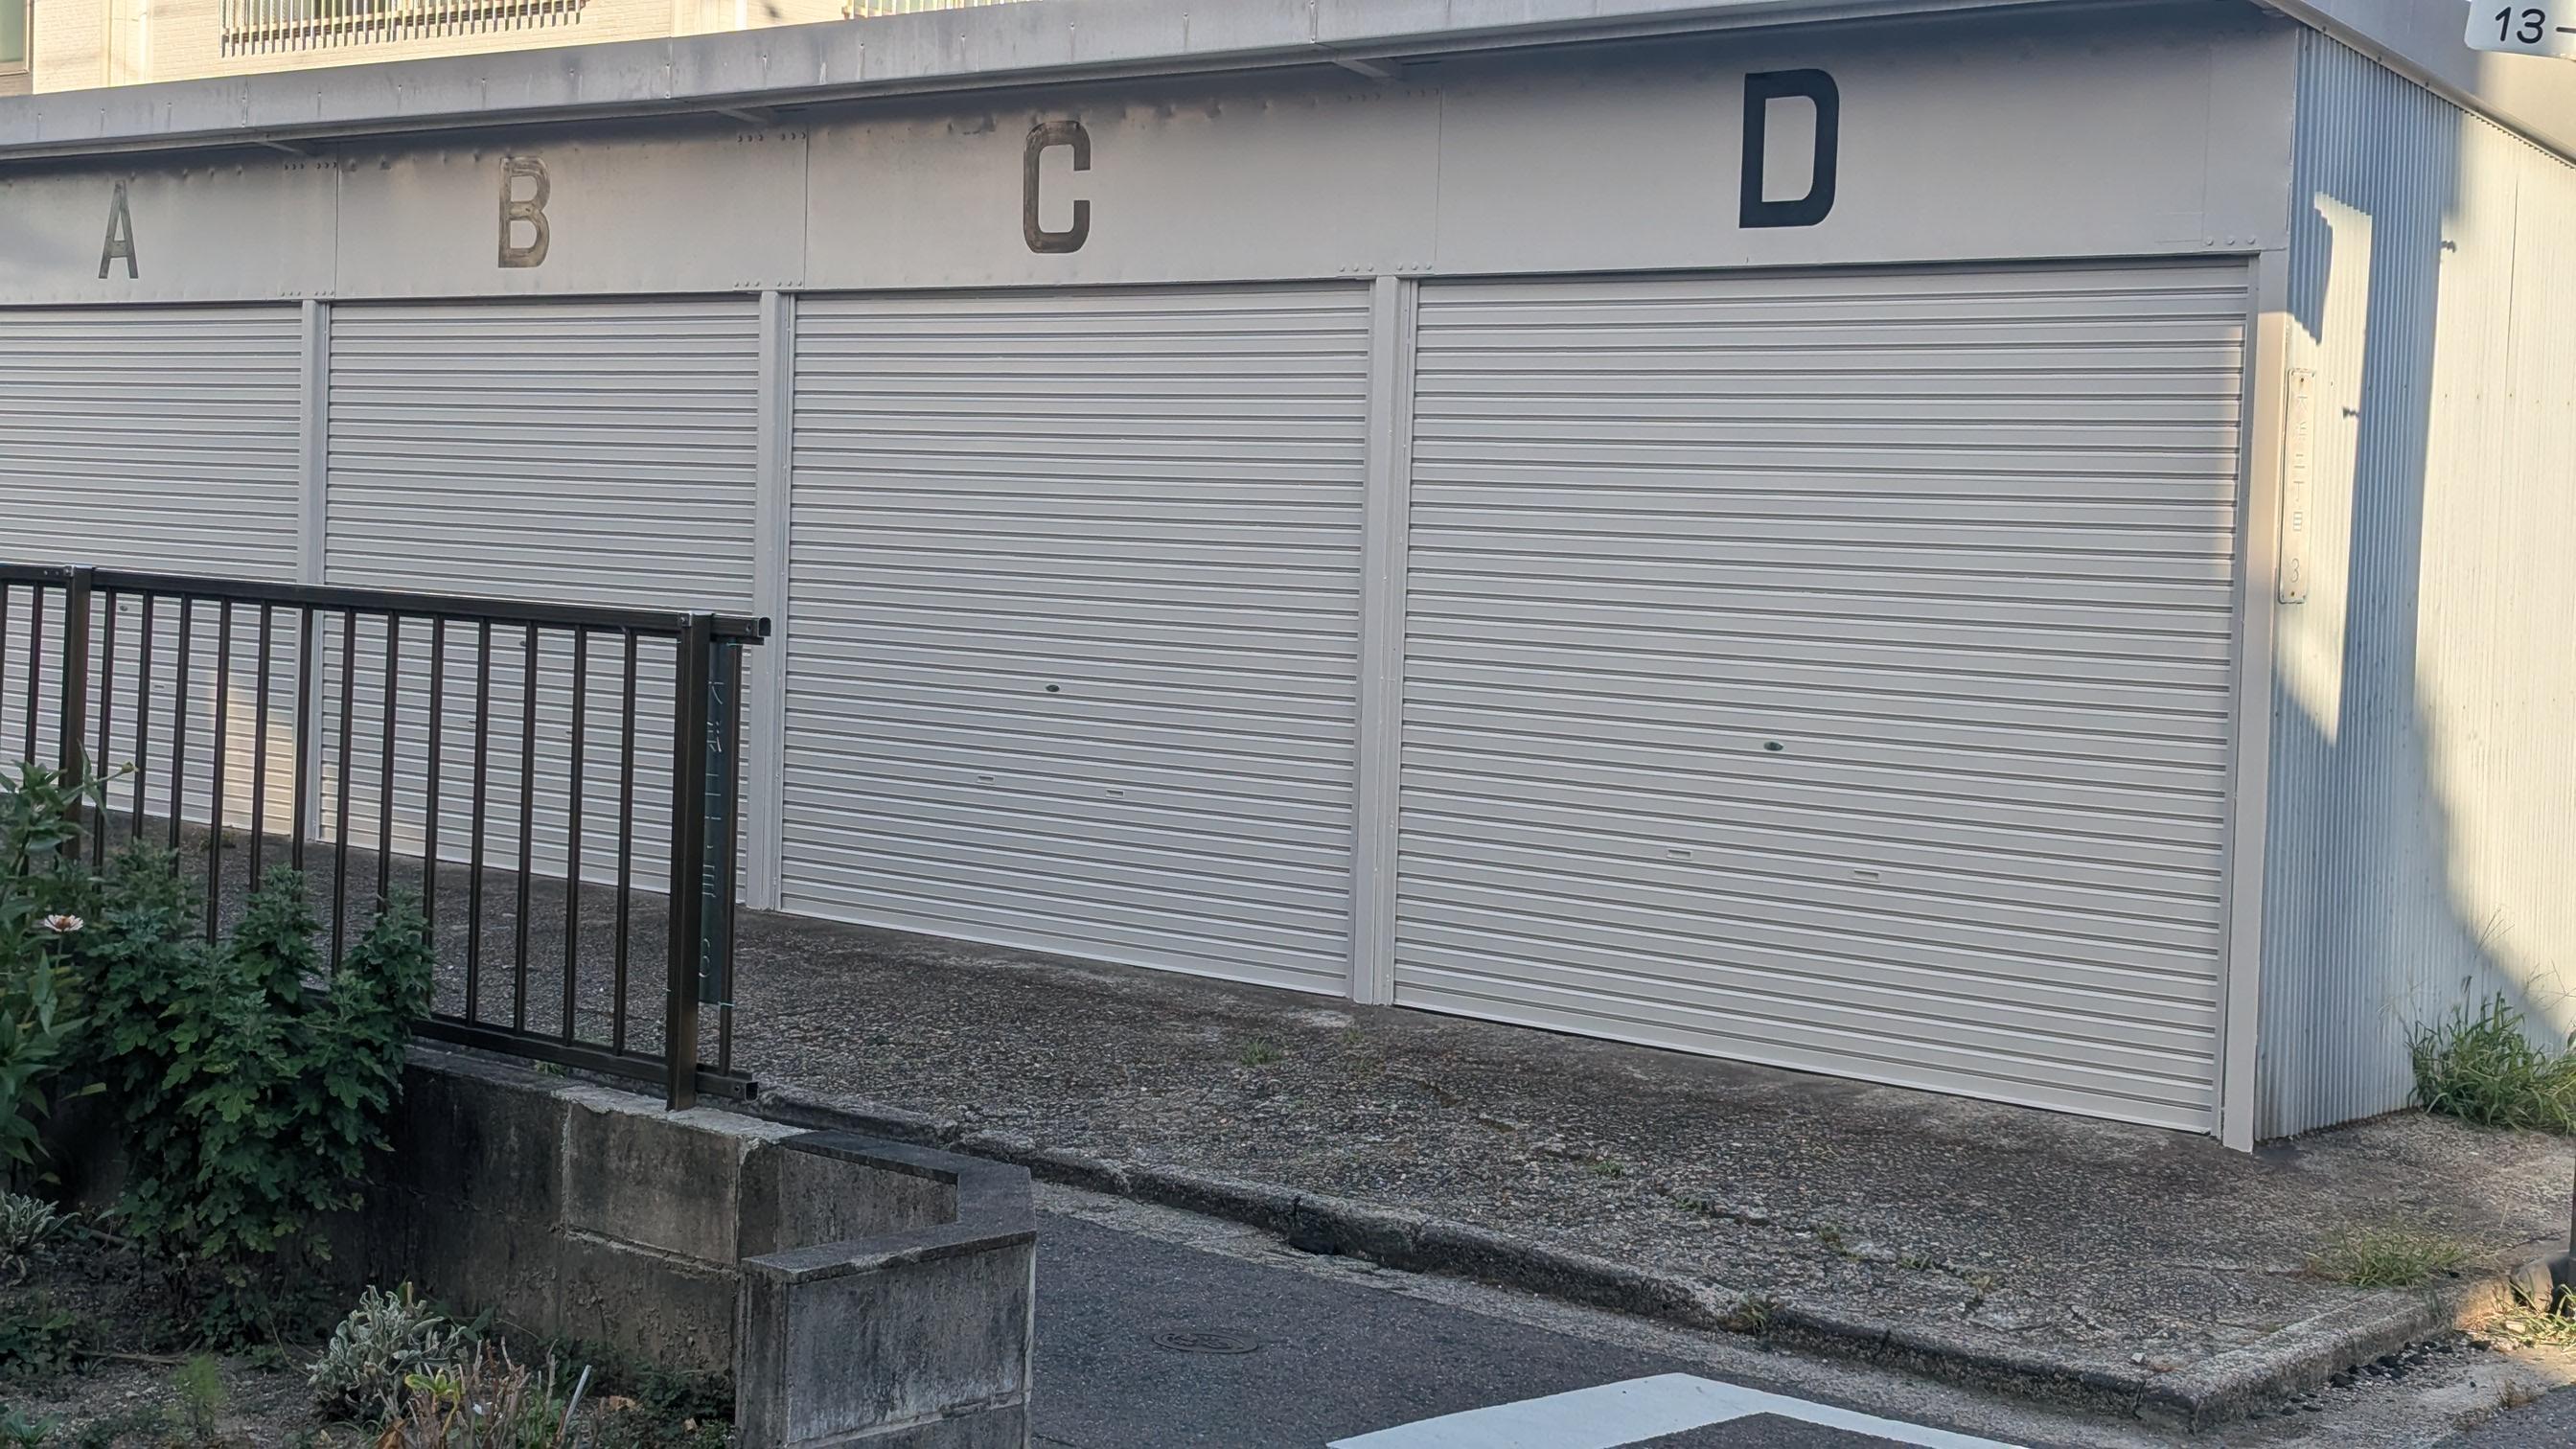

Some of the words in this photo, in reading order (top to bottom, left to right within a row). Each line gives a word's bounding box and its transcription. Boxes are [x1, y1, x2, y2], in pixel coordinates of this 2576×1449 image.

[1023, 120, 1092, 254] C
[1738, 68, 1840, 229] D
[98, 179, 139, 280] A
[497, 156, 551, 268] B
[2289, 558, 2300, 584] 3
